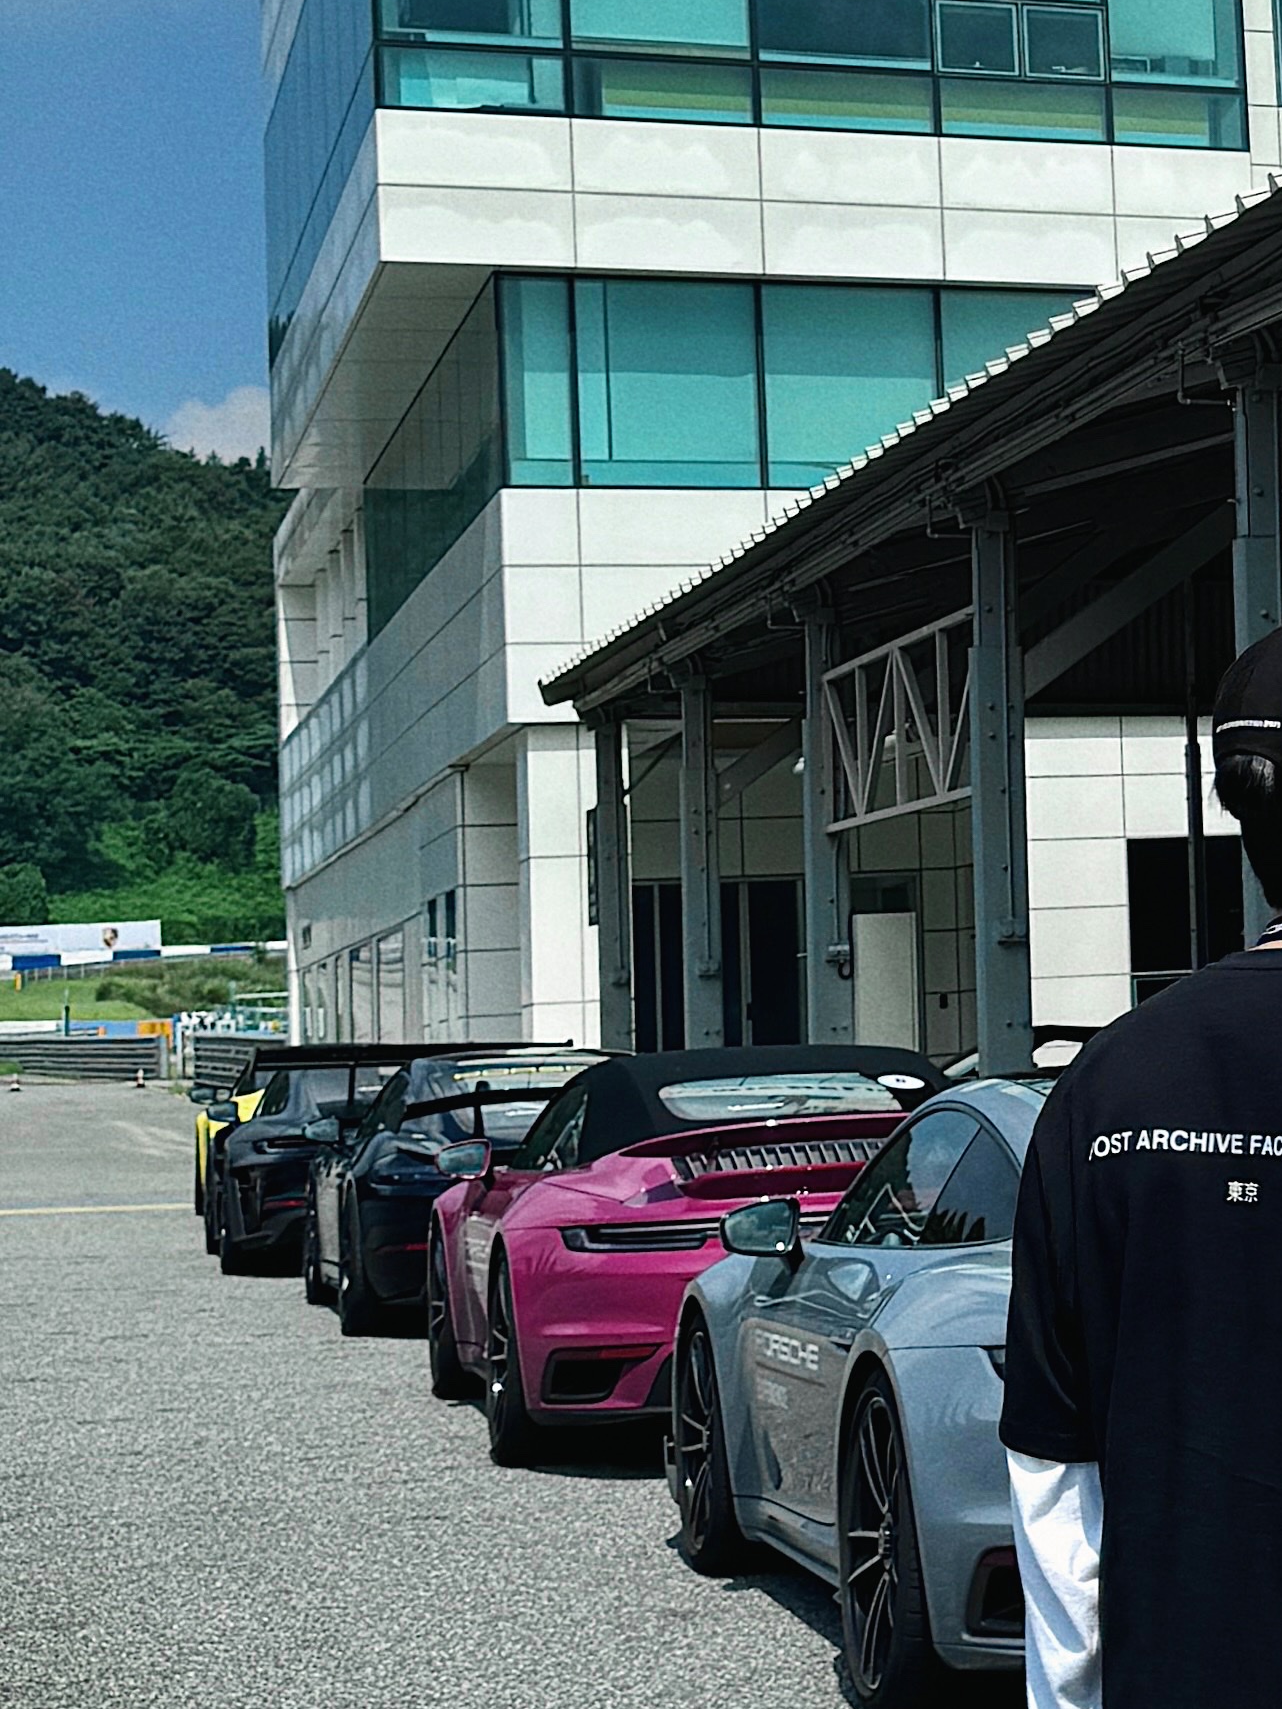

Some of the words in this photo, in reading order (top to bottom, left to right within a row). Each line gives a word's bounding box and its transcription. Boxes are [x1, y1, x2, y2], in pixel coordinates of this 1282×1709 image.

[1088, 1131, 1133, 1161] OST
[1135, 1129, 1244, 1154] ARCHIVE
[1226, 1180, 1259, 1202] 東京
